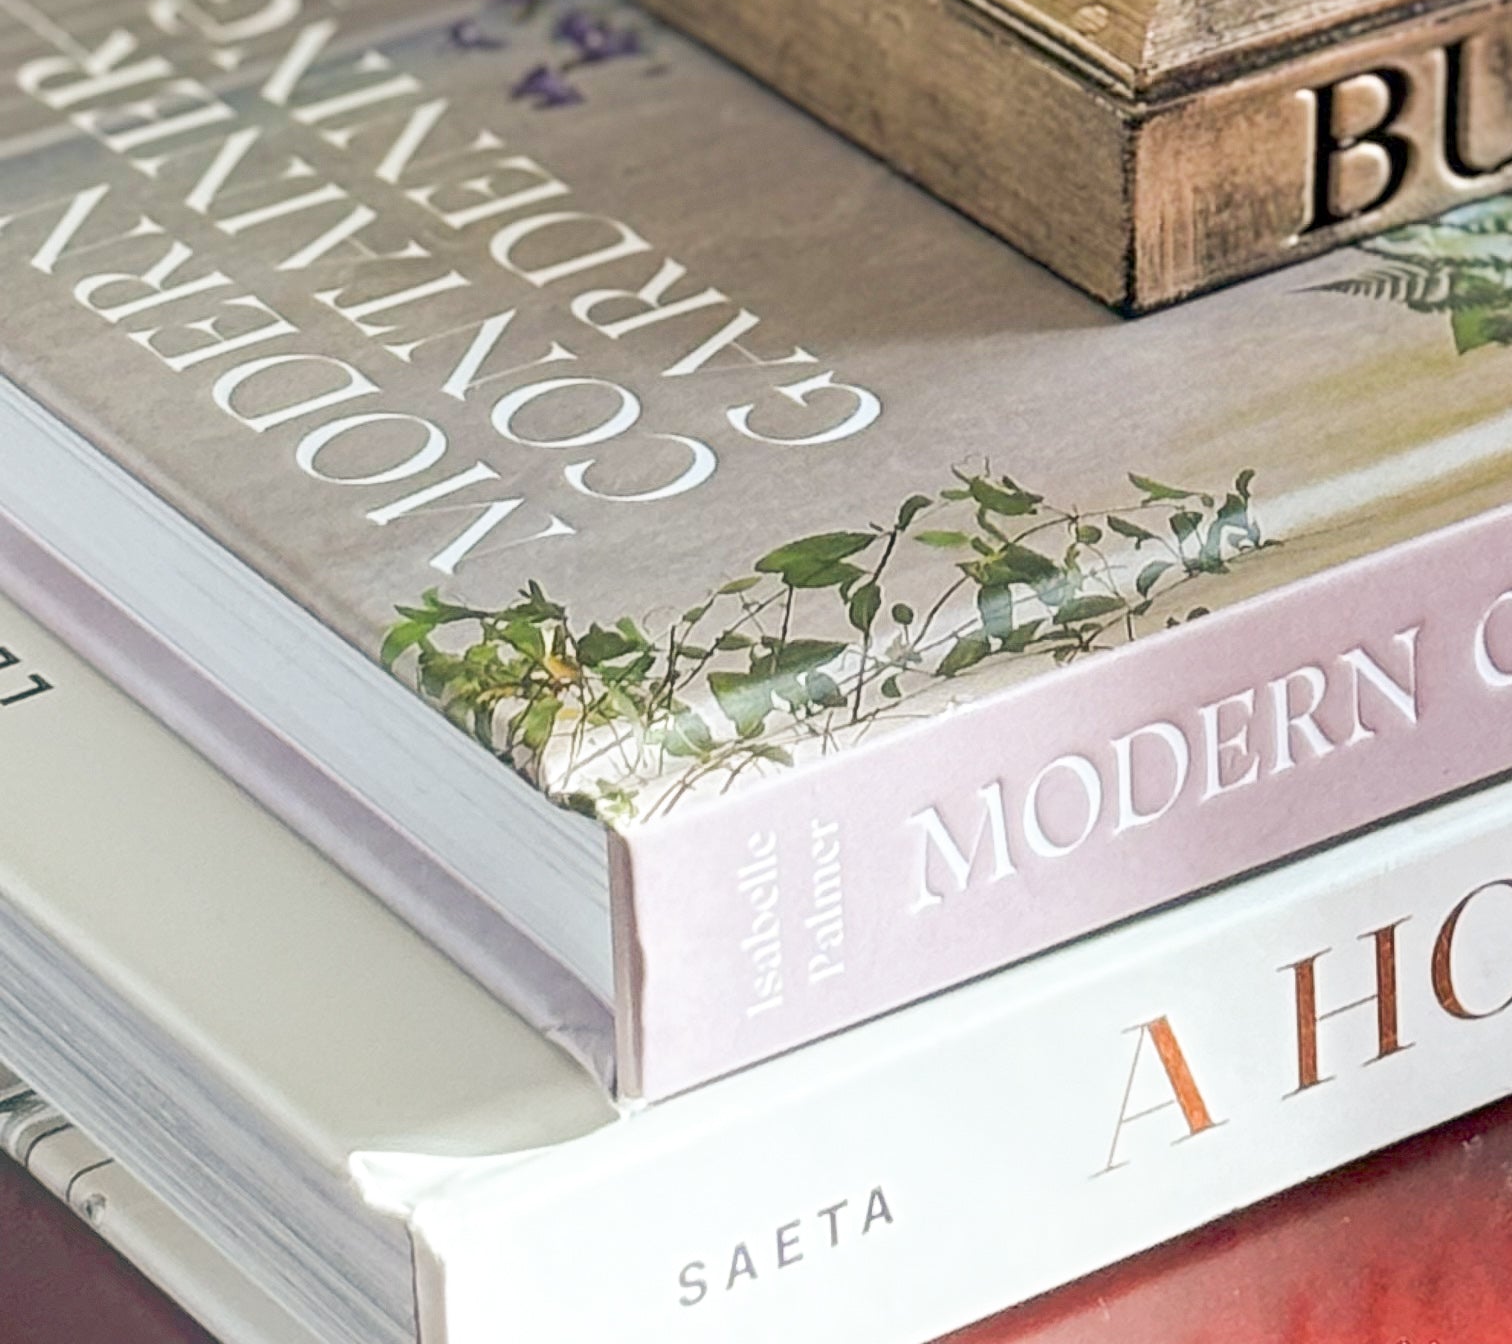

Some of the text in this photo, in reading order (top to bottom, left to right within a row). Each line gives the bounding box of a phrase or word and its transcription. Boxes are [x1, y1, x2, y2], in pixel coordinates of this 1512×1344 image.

[16, 27, 718, 504] CONTAINER
[0, 182, 577, 576] MODERN
[907, 626, 1422, 914] MODERN
[737, 830, 783, 1018] Isabelle
[804, 818, 845, 983] Palmer
[1088, 1014, 1230, 1180] A
[676, 1185, 897, 1309] SAETA
